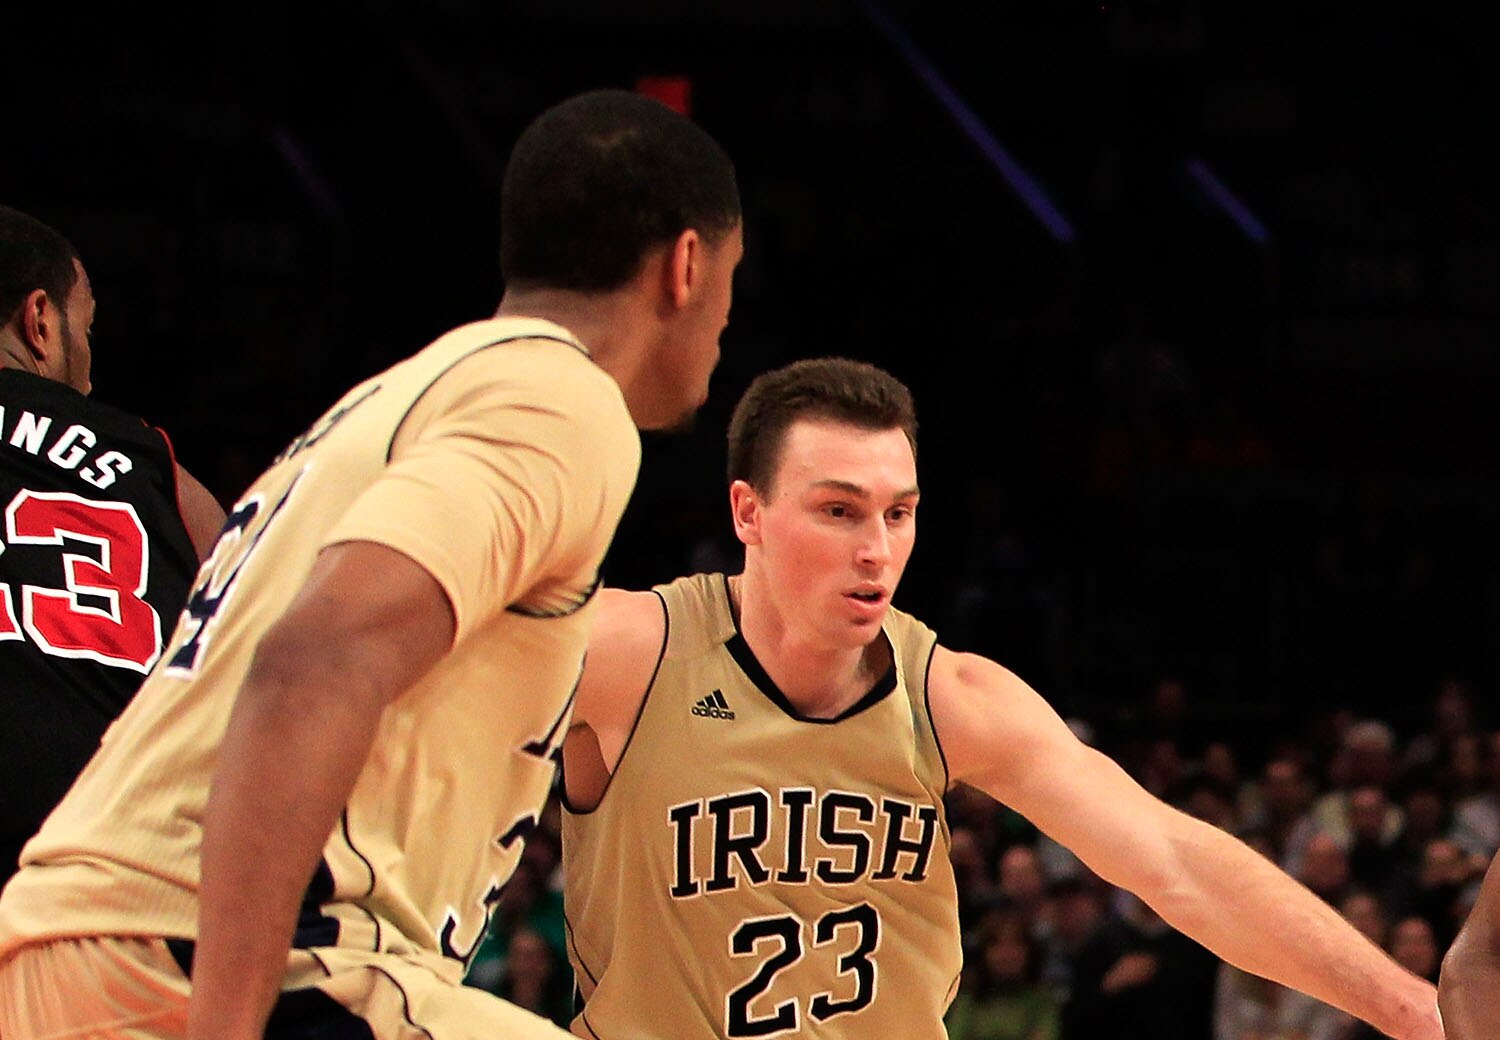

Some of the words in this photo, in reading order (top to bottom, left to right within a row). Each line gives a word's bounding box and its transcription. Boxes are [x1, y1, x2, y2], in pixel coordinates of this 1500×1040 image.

[0, 488, 162, 676] 3
[691, 704, 736, 721] adidas
[667, 787, 939, 900] IRISH
[724, 901, 883, 1040] 23
